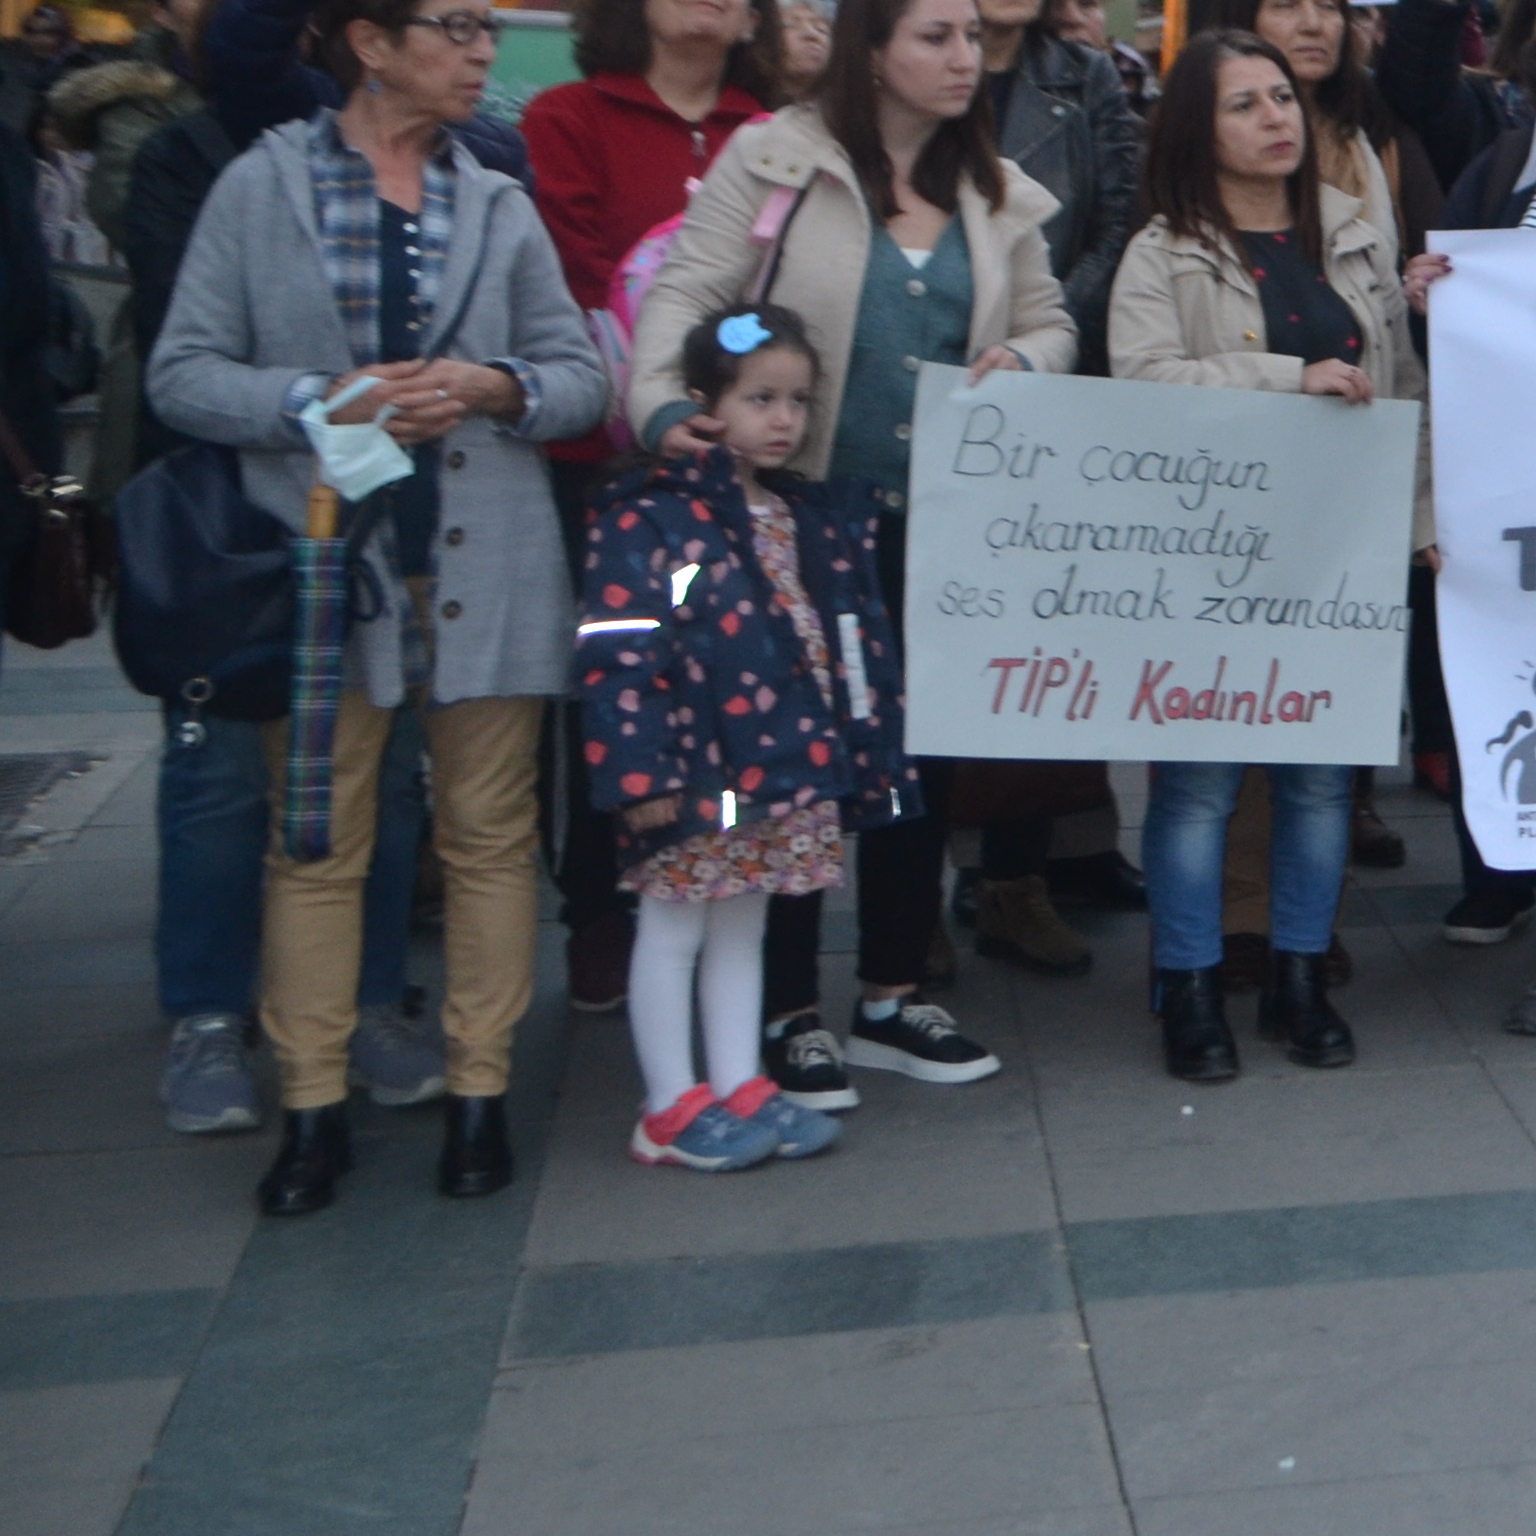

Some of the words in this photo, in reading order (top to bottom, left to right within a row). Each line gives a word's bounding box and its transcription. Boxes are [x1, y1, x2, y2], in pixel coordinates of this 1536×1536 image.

[952, 404, 1057, 479] Bir
[1080, 443, 1270, 511] çocuğun
[937, 579, 1005, 617] ses
[1032, 564, 1175, 621] olmak
[1129, 655, 1332, 725] Kadınlar
